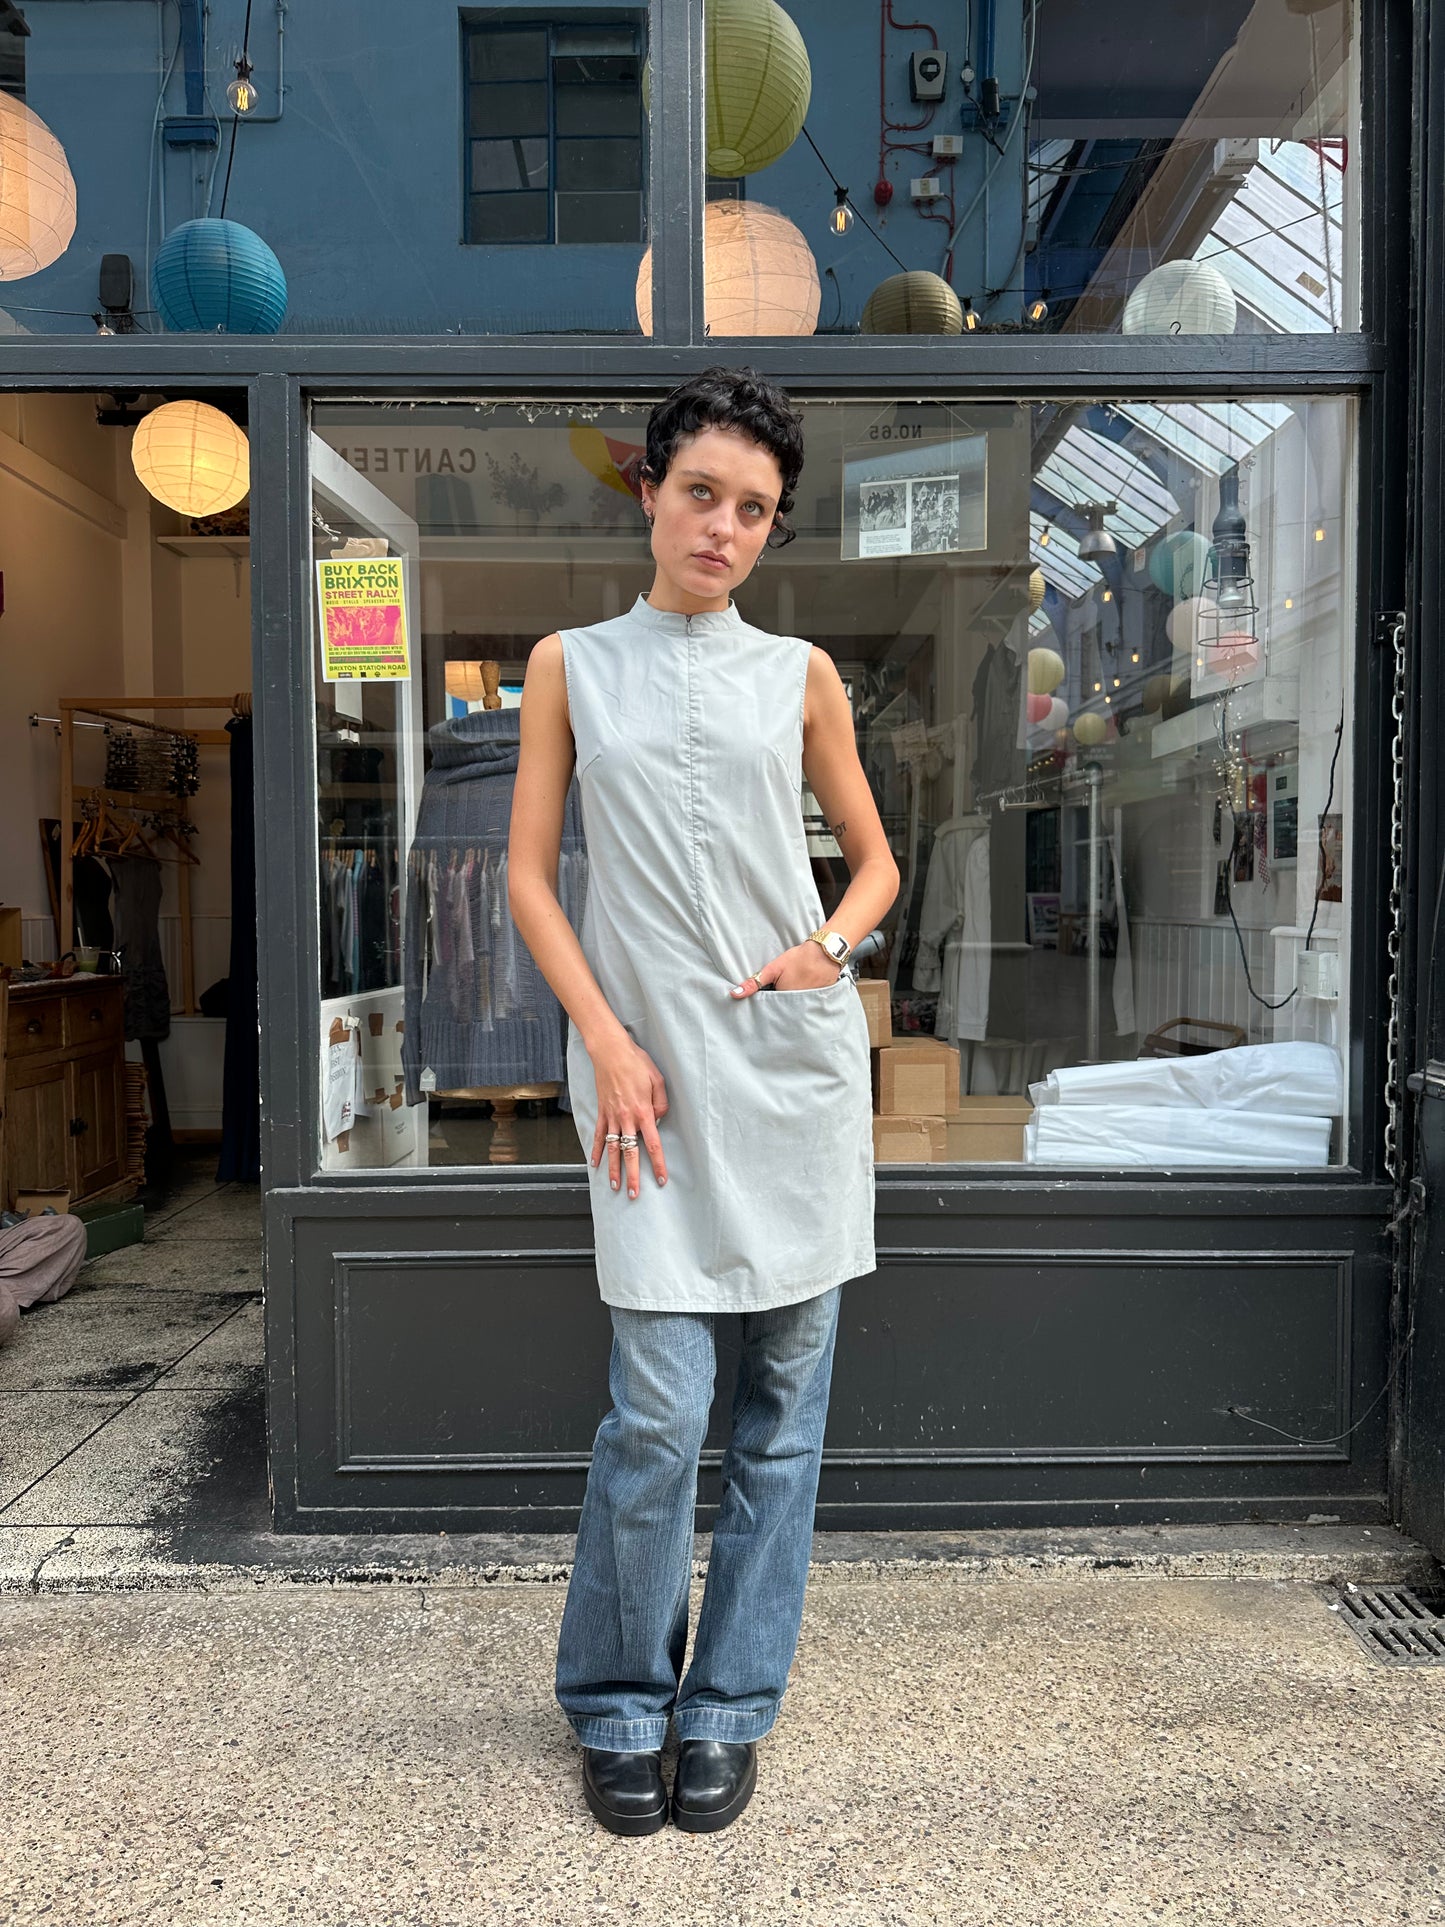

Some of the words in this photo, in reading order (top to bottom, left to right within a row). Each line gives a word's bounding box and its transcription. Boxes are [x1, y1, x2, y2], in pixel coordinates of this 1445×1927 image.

[324, 565, 353, 576] BUY
[358, 564, 397, 575] BACK
[325, 575, 399, 589] BRIXTON
[325, 590, 363, 599] STREET
[366, 589, 398, 598] RALLY
